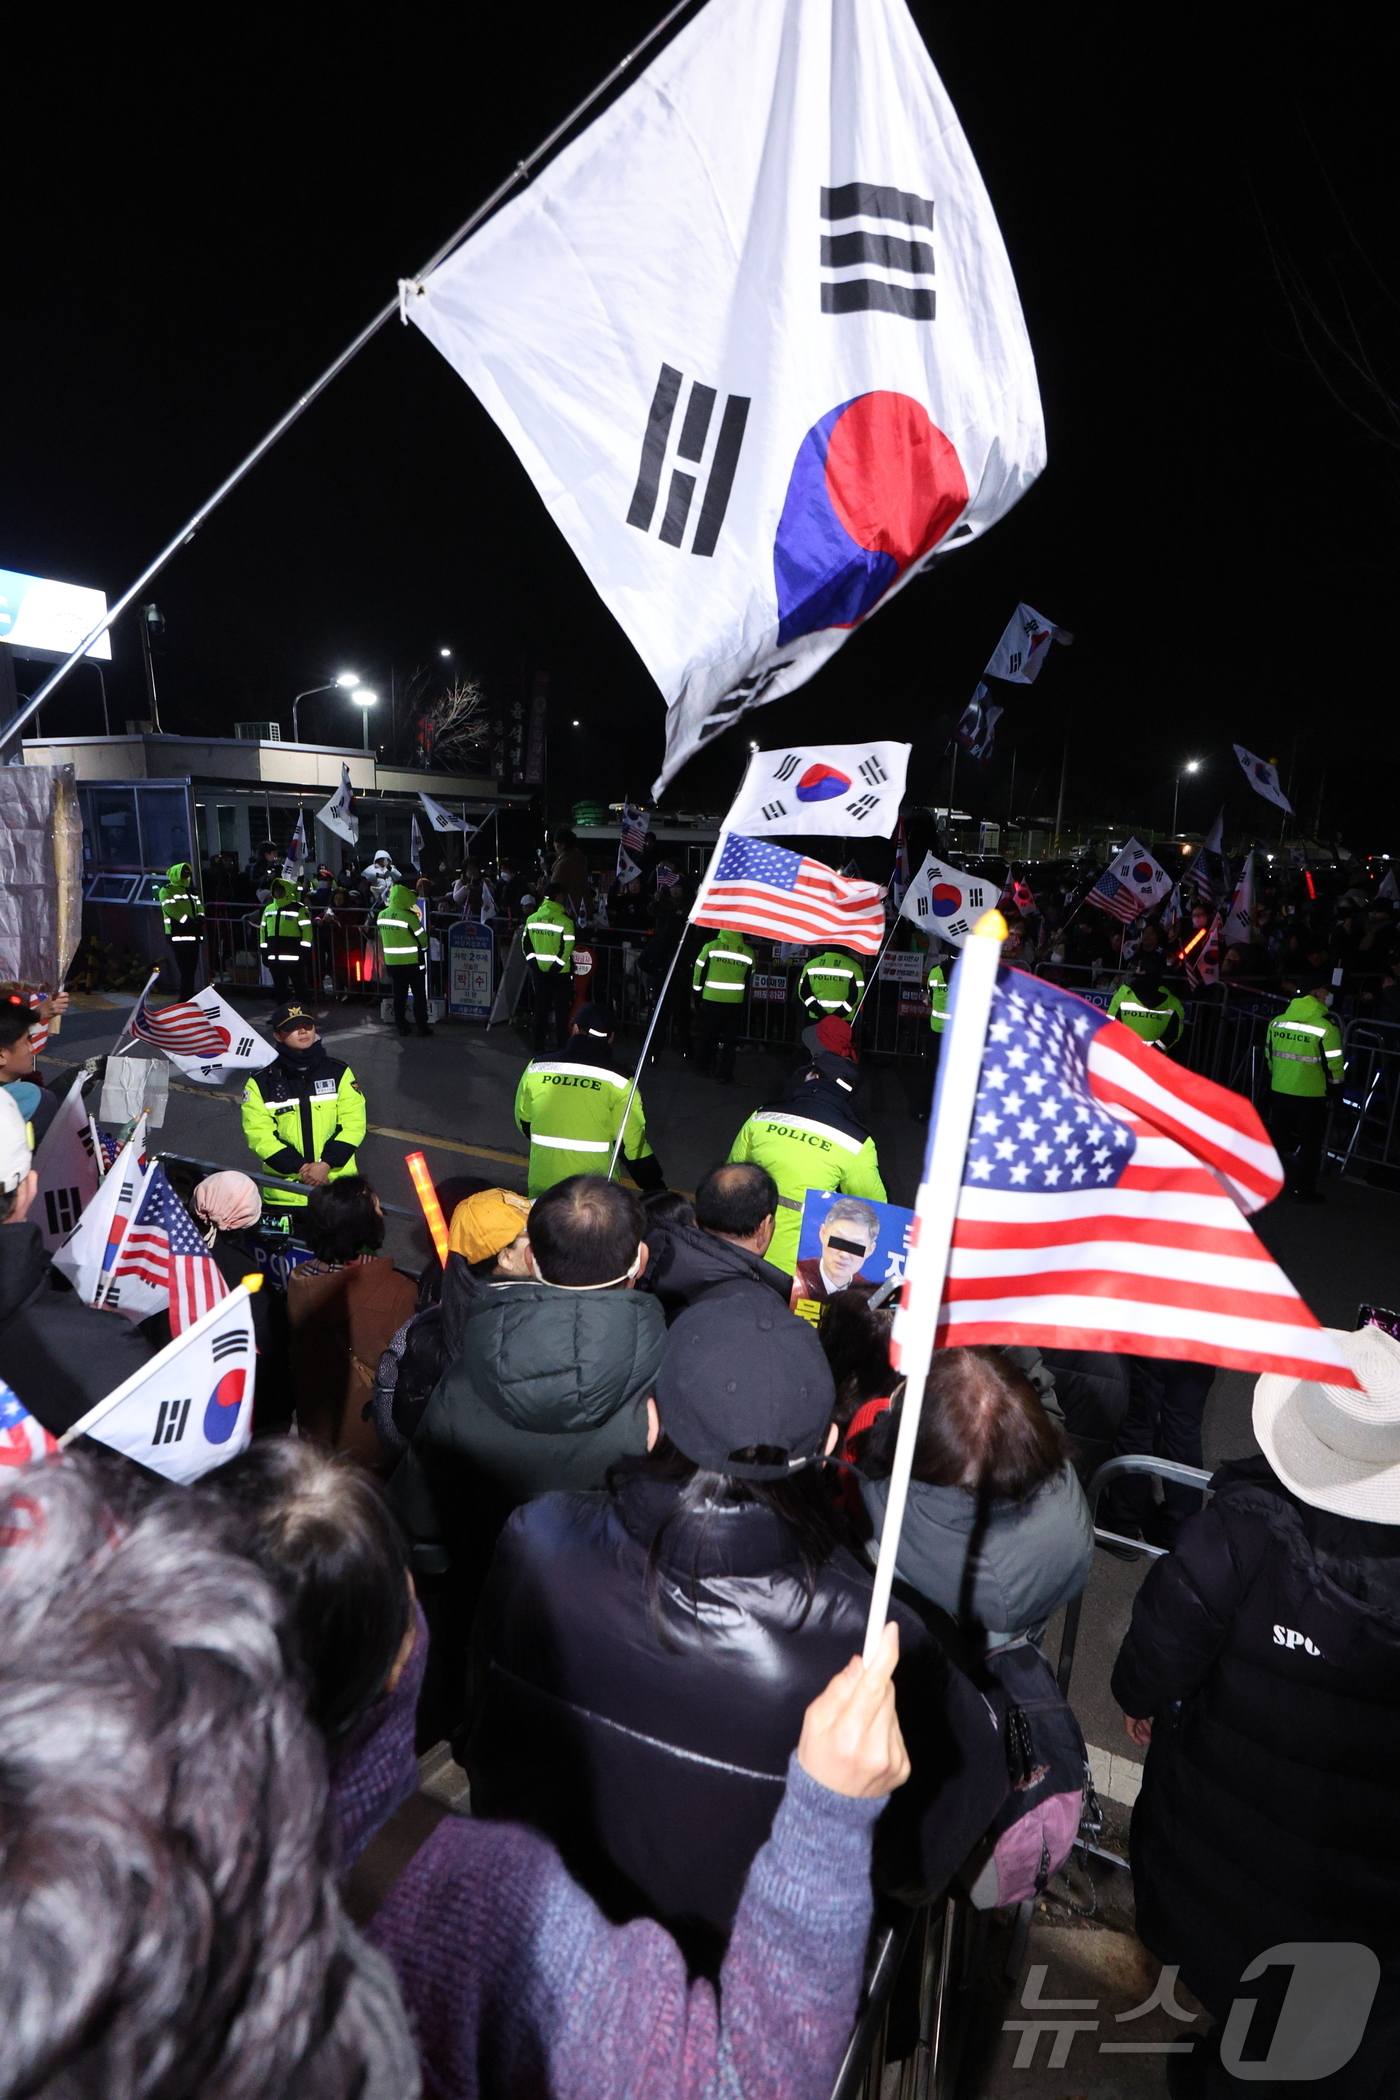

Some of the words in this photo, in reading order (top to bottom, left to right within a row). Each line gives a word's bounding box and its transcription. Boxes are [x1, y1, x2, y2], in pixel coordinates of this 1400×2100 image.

[716, 958, 746, 967] POLICE
[818, 958, 842, 967] 경찰
[760, 977, 786, 987] 이재명
[813, 974, 845, 982] POLICE
[1085, 994, 1109, 1007] POL
[1124, 1010, 1163, 1020] POLICE
[1274, 1031, 1311, 1043] POLICE
[542, 1075, 602, 1091] POLICE
[766, 1124, 832, 1152] POLICE
[1273, 1624, 1326, 1658] SPO
